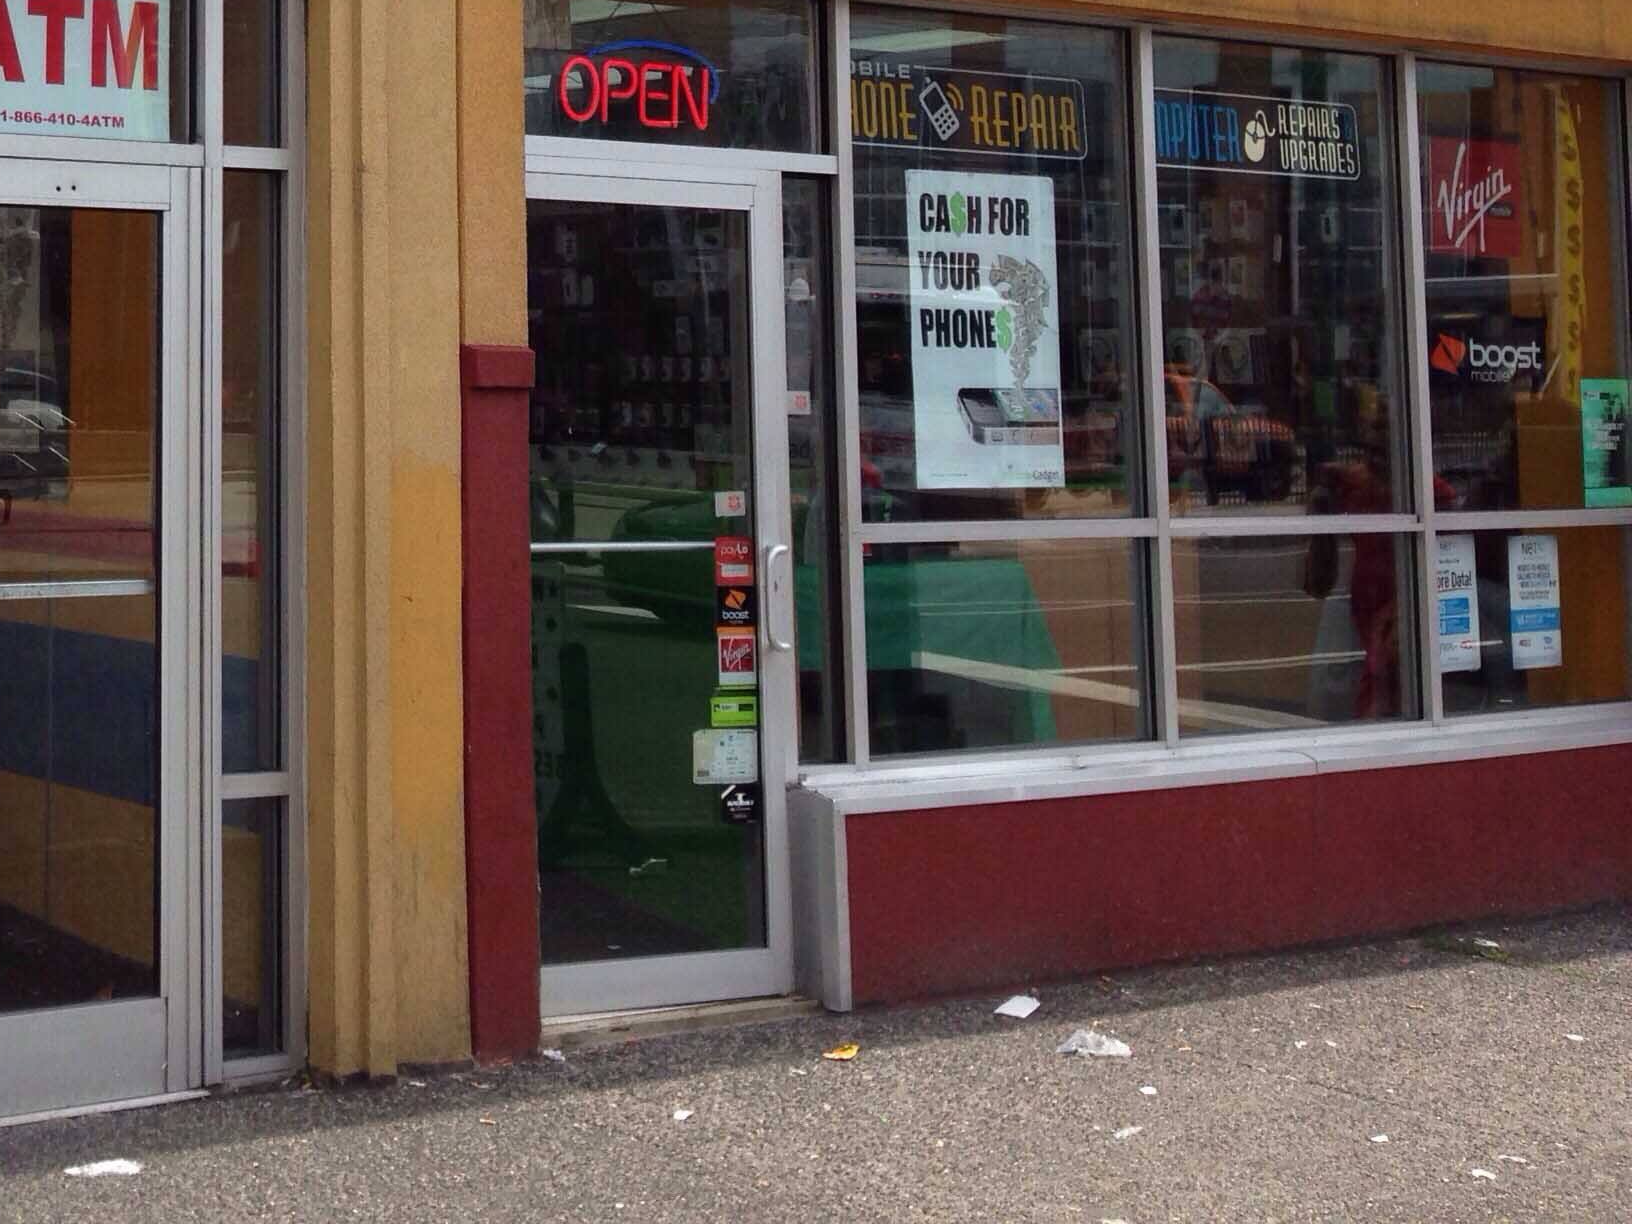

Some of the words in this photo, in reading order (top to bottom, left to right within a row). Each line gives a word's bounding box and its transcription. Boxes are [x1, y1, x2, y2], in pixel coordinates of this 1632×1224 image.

[559, 54, 709, 130] OPEN
[0, 109, 126, 130] 1-866-410-4ATM
[970, 84, 1080, 151] REPAIR
[1277, 104, 1342, 140] REPAIRS
[1279, 139, 1357, 175] UPGRADES
[988, 195, 1030, 238] FOR
[1437, 142, 1512, 253] Virgin
[917, 250, 981, 293] YOUR
[1469, 337, 1543, 373] boost
